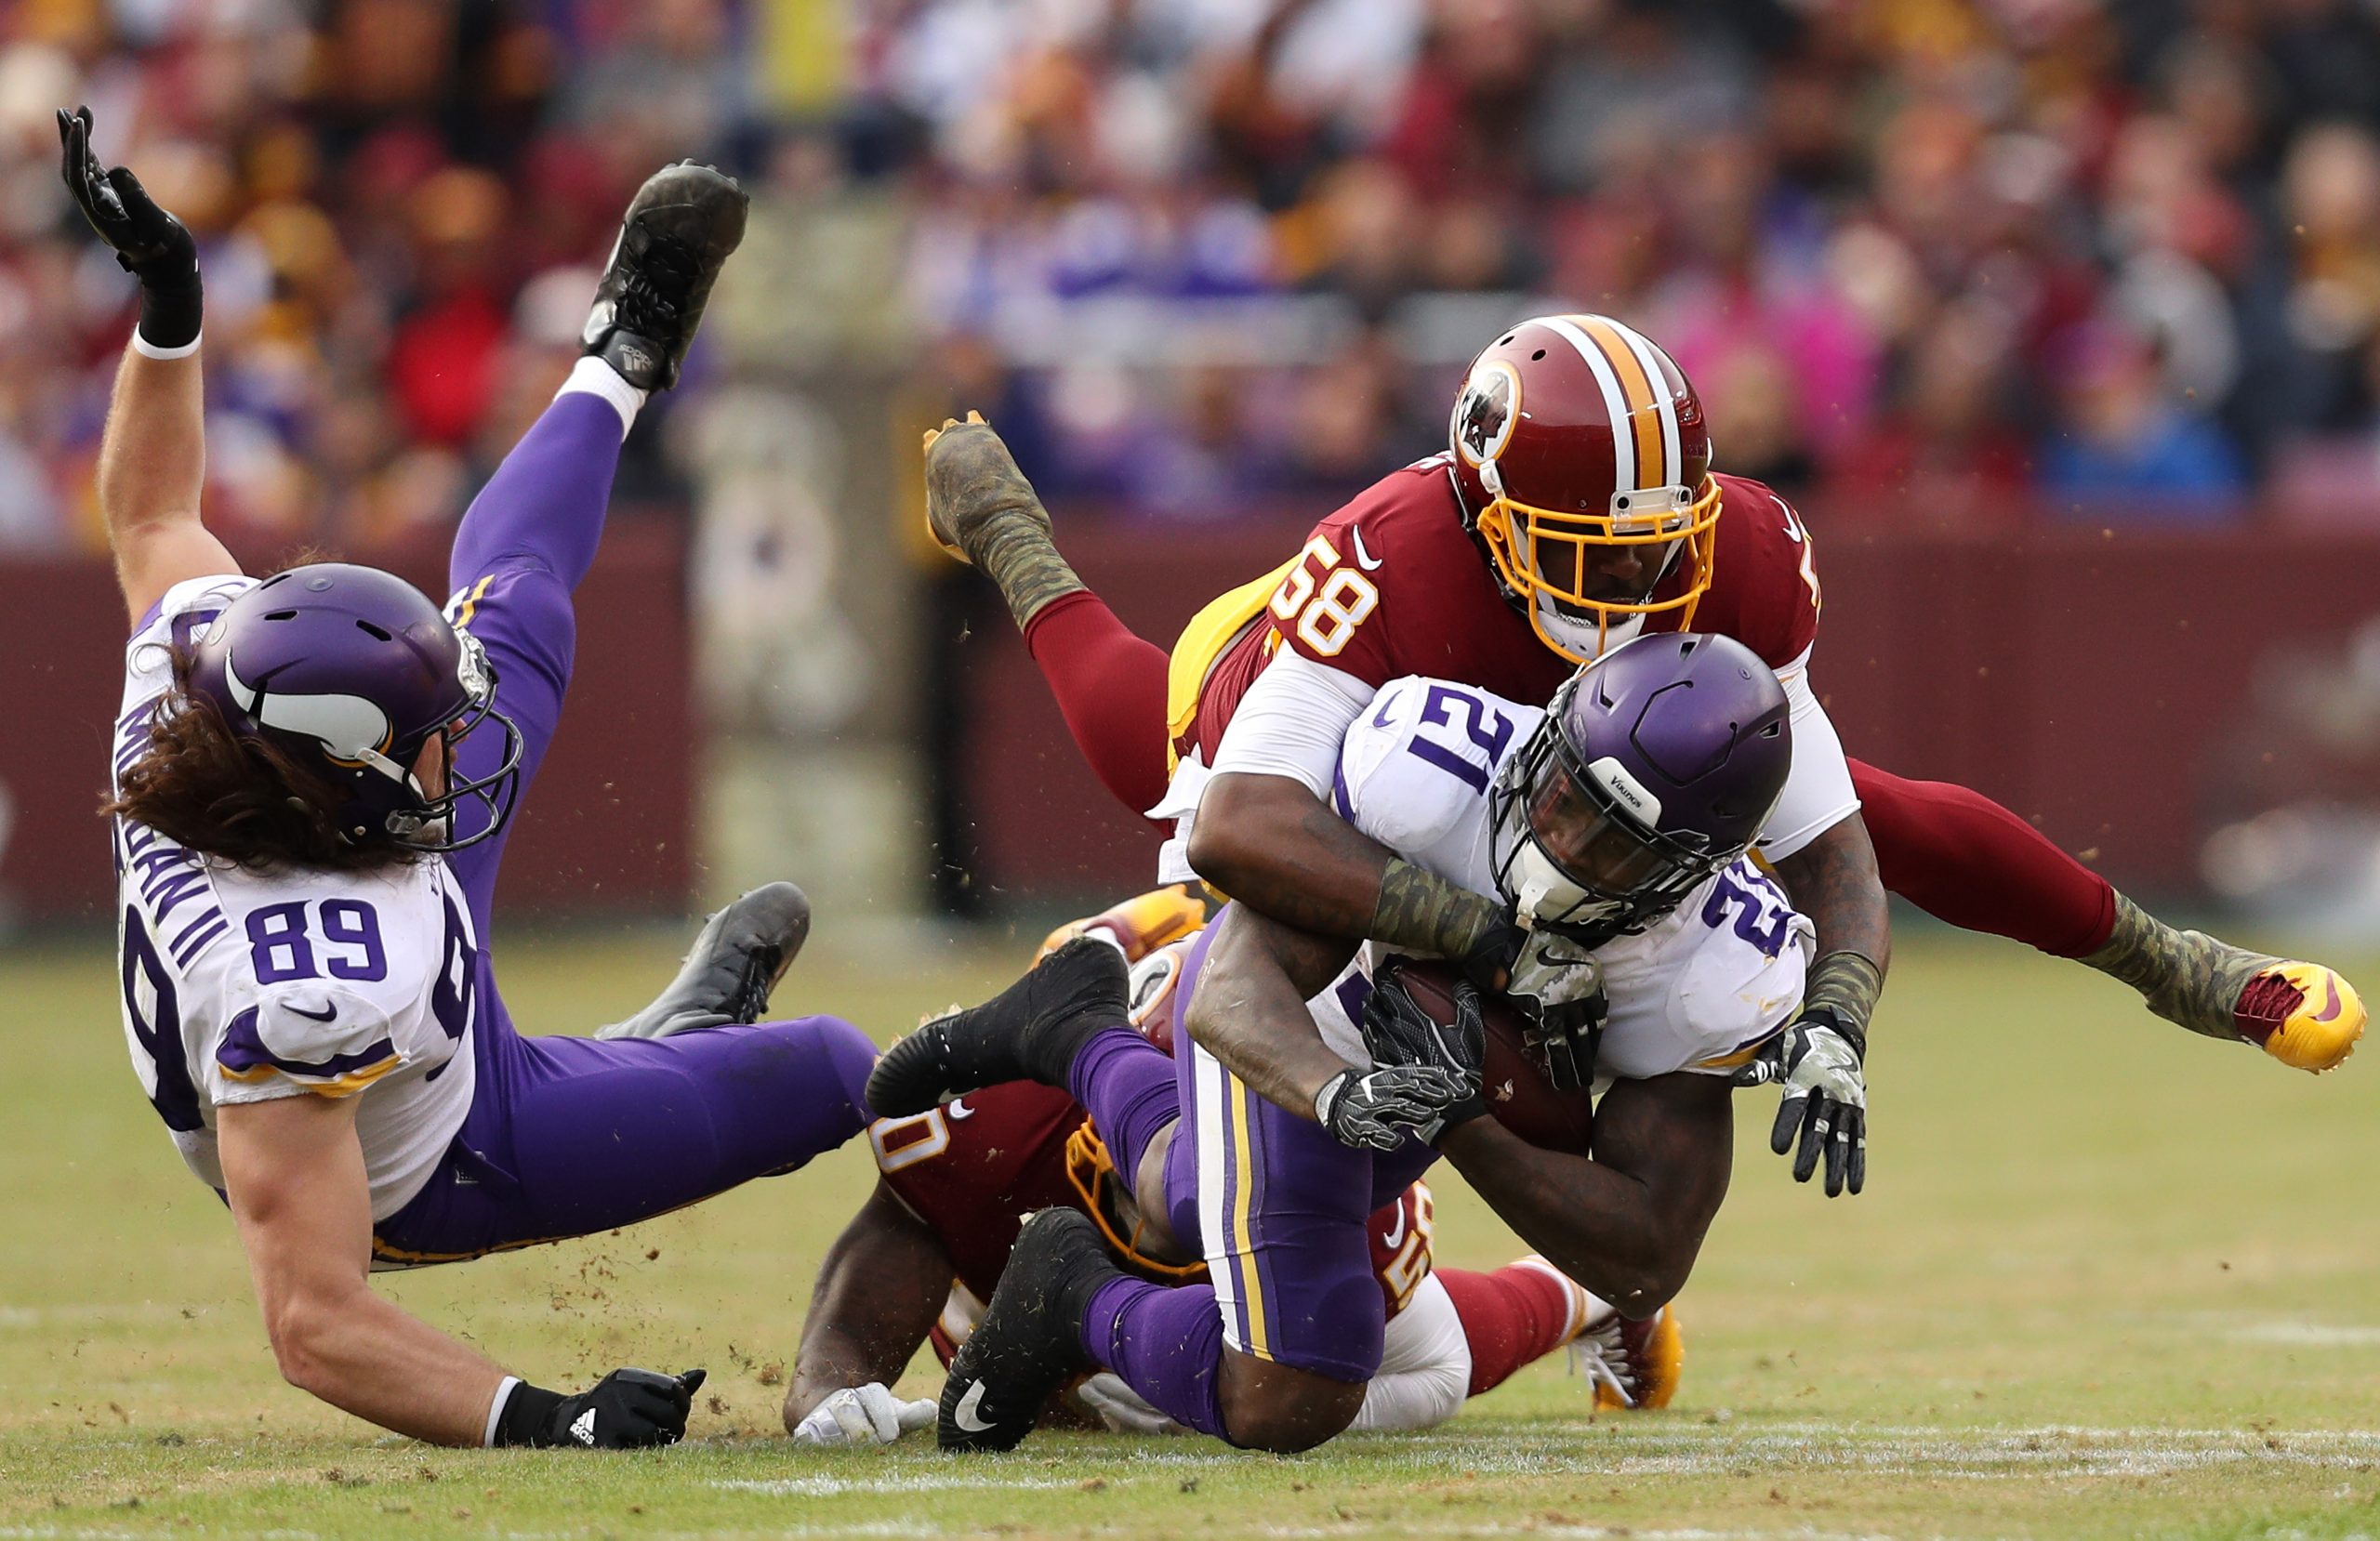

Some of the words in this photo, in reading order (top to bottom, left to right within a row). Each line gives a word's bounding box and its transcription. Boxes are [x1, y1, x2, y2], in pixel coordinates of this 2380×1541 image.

[1269, 534, 1379, 656] 58
[1408, 685, 1515, 796] 21
[169, 905, 230, 970] II
[246, 899, 388, 986] 89
